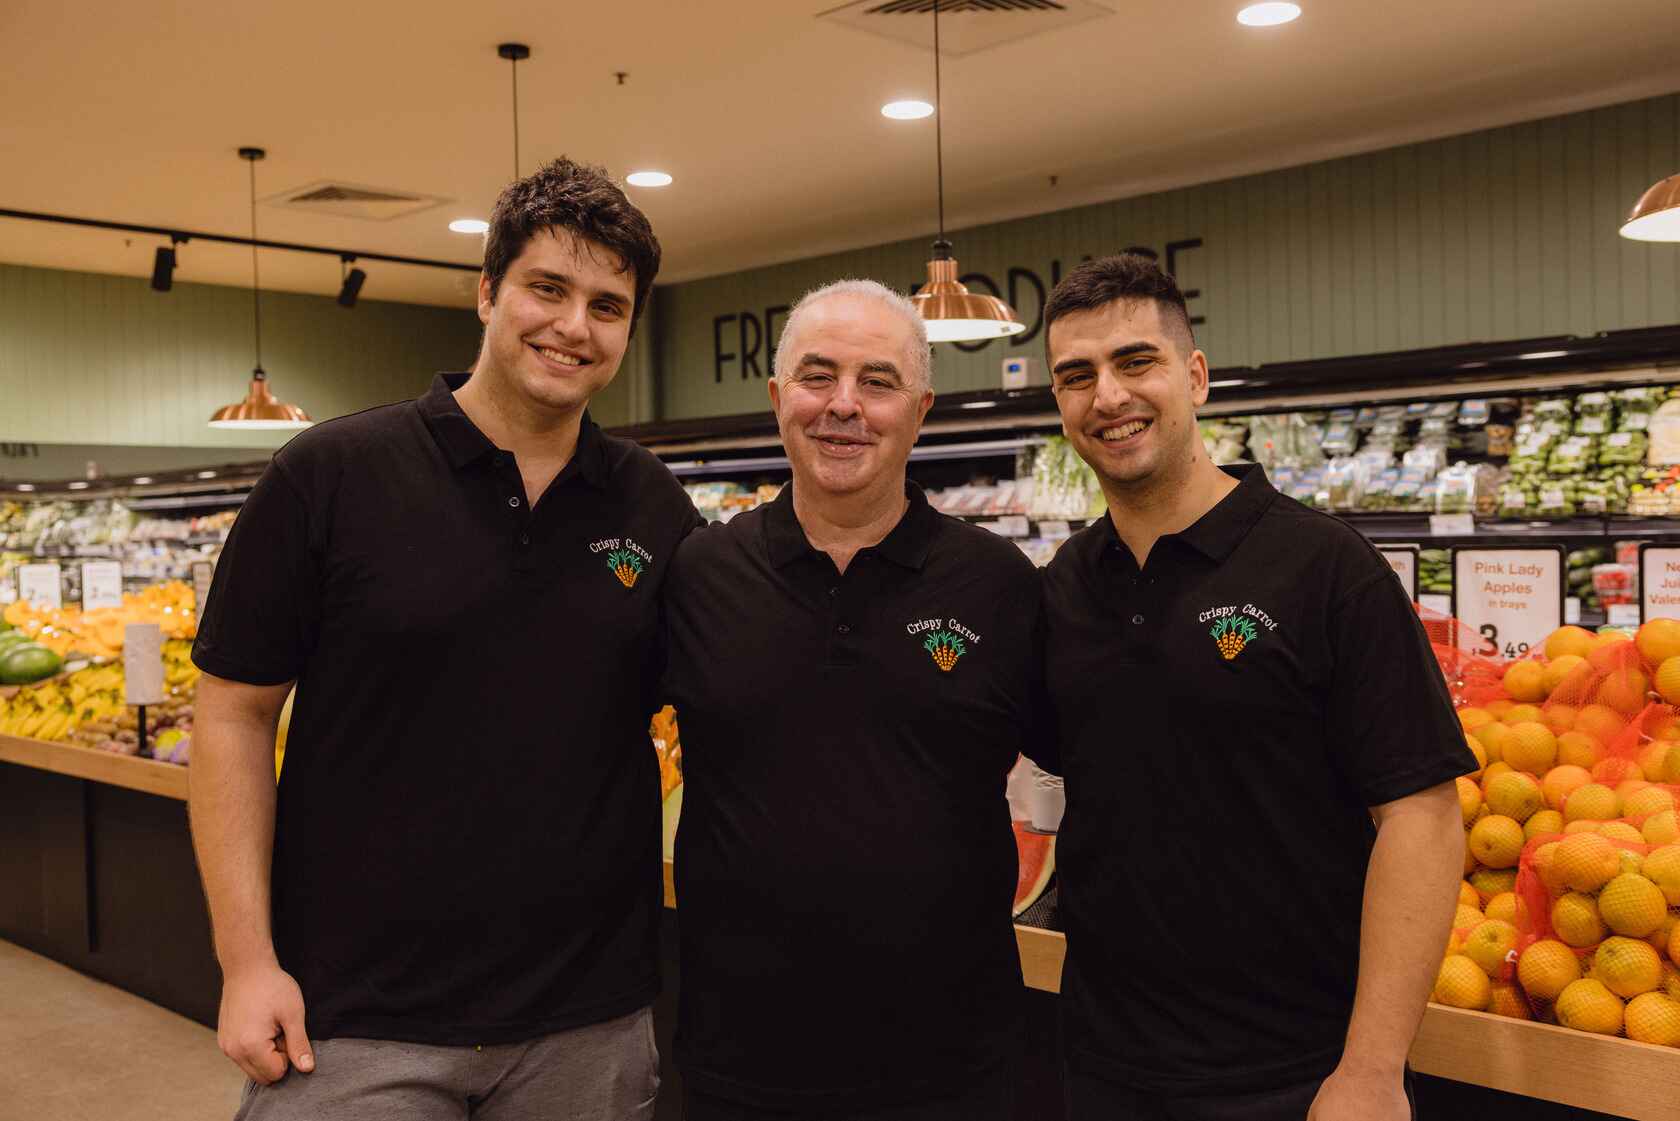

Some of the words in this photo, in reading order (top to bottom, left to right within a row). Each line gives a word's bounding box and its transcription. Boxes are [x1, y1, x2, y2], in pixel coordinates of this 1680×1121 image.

[589, 538, 620, 553] Crispy
[625, 538, 653, 563] Carrot
[1474, 561, 1504, 574] Pink
[1509, 562, 1544, 577] Lady
[1484, 581, 1533, 595] Apples
[1199, 605, 1237, 623] Crispy
[1242, 603, 1279, 632] Carrot
[906, 618, 942, 635] Crispy
[948, 618, 981, 644] Carrot
